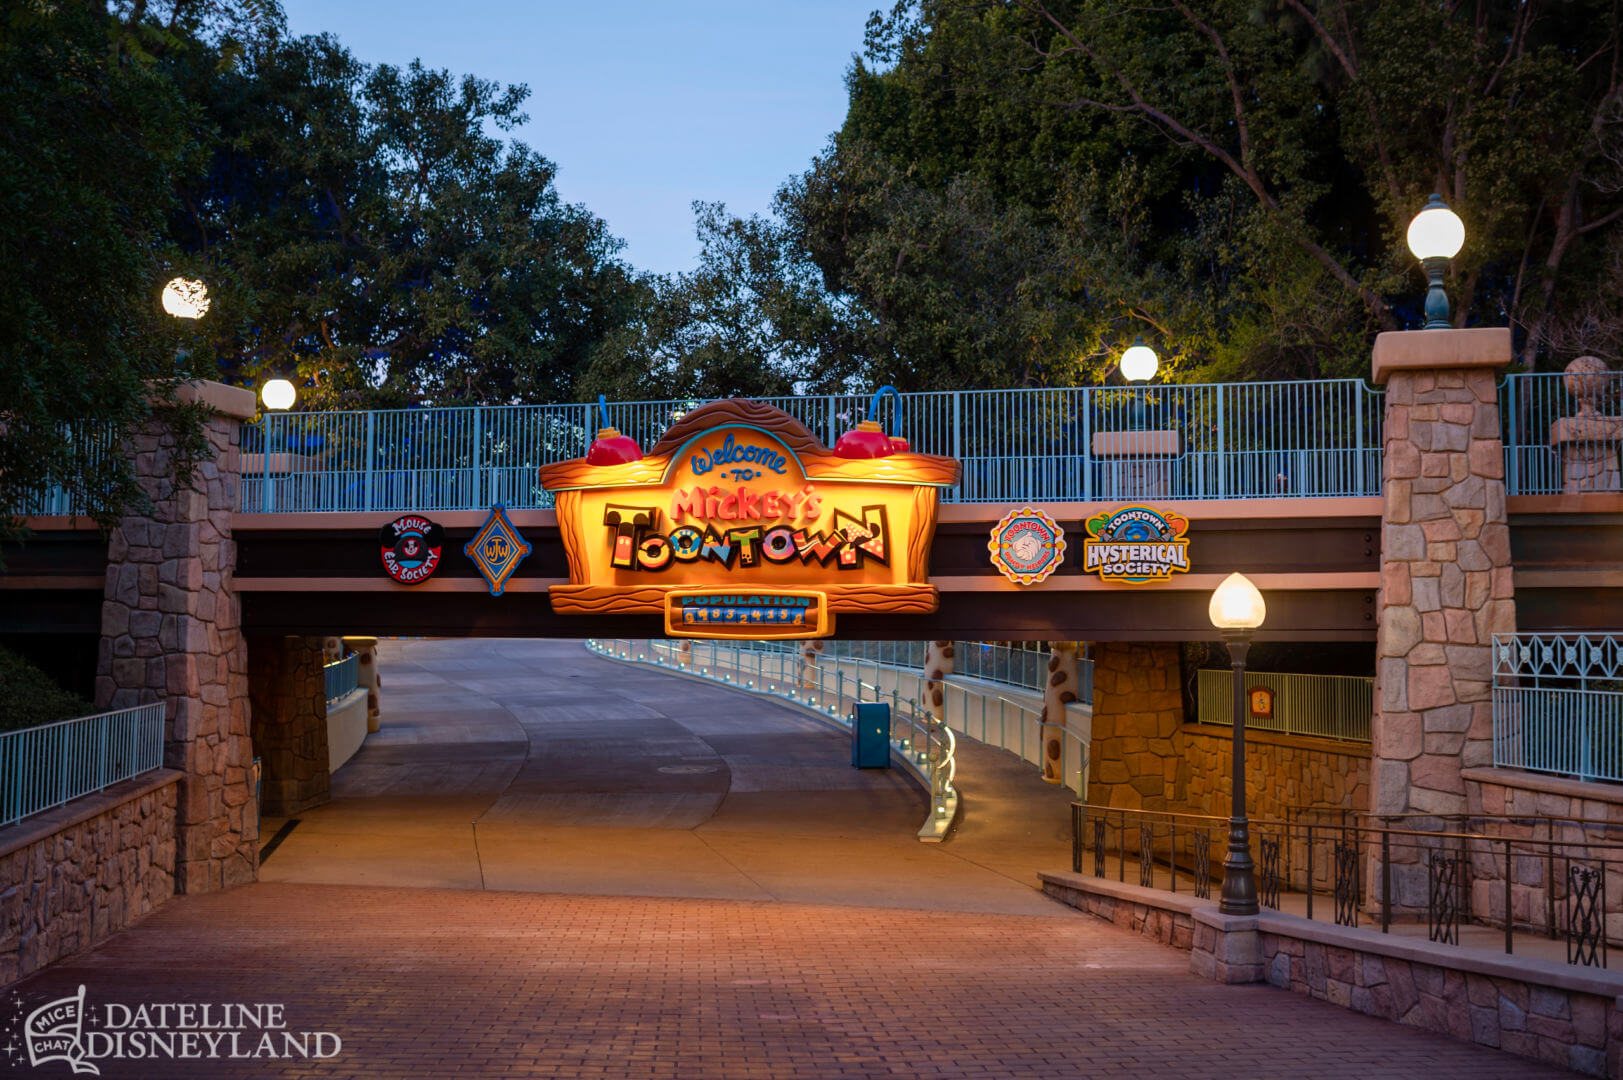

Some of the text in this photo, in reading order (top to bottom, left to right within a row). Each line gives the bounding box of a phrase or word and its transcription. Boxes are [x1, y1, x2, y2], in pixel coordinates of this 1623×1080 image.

[691, 433, 787, 475] Welcome
[730, 468, 753, 482] TO
[392, 518, 432, 536] MOUSE
[1004, 521, 1051, 541] TOONTOWN
[1108, 511, 1165, 531] TOONTOWN
[604, 502, 890, 572] TOONTOWN
[384, 549, 438, 581] EAR SOCIETY
[1087, 544, 1187, 568] HYSTERICAL
[1103, 562, 1170, 574] SOCiETY
[682, 595, 810, 606] POPULATION
